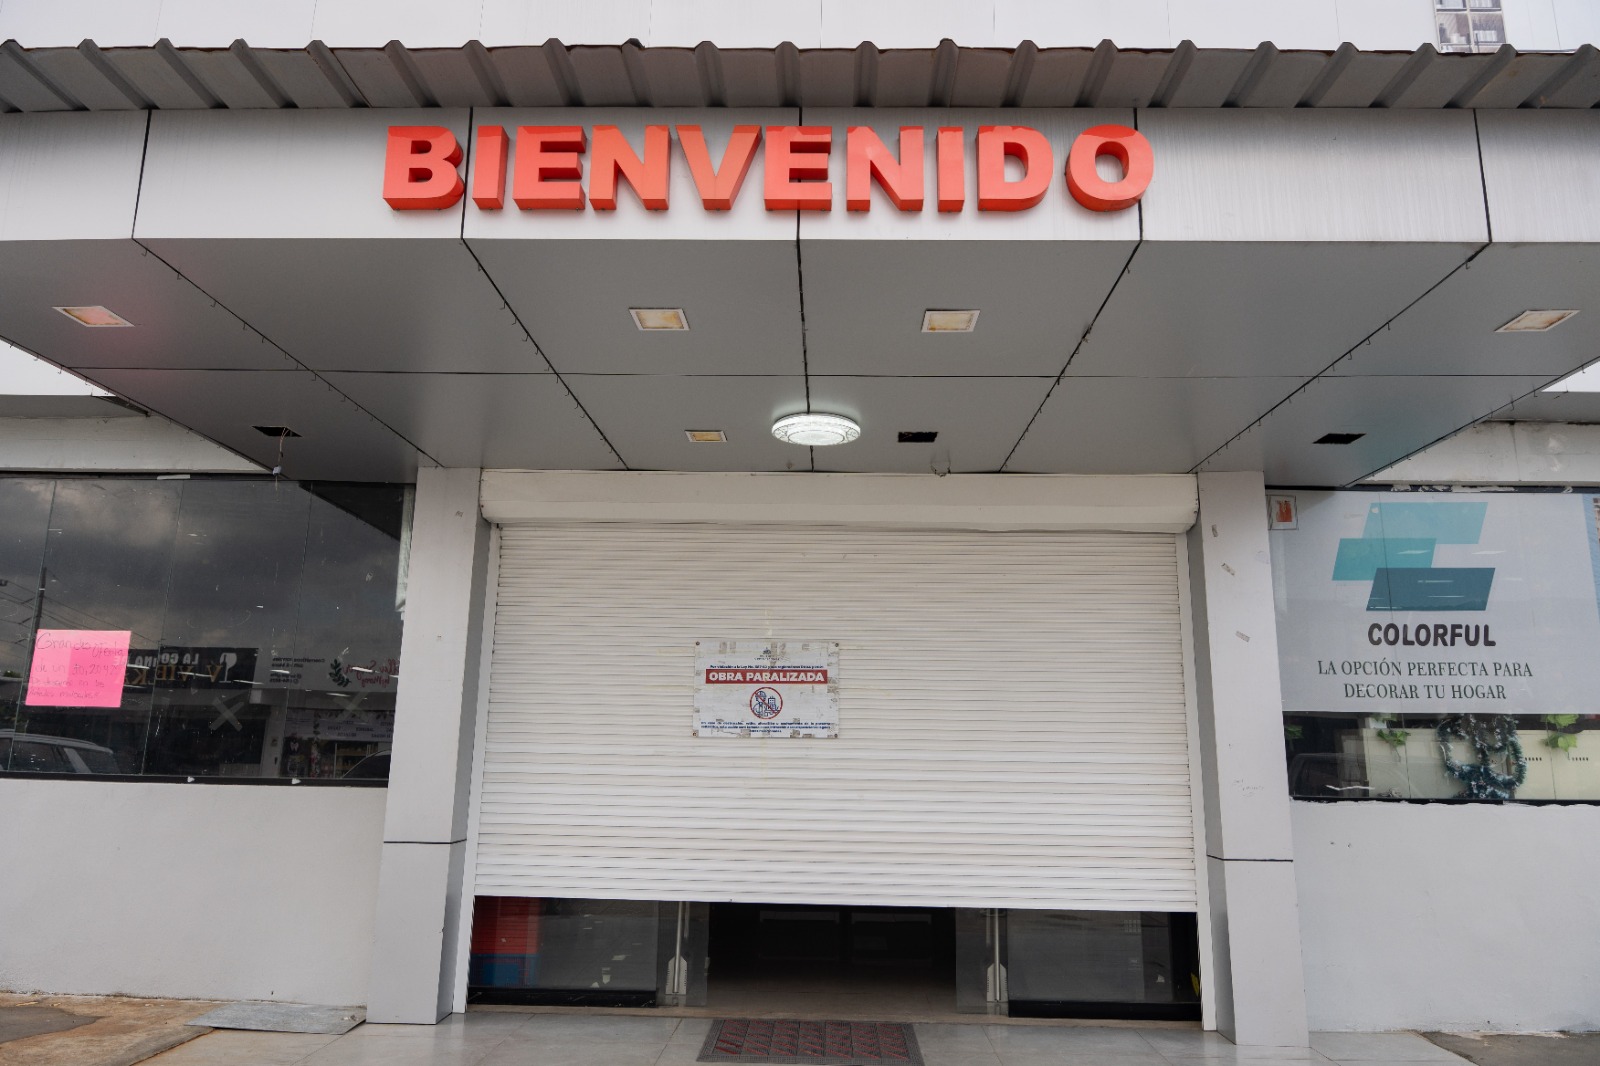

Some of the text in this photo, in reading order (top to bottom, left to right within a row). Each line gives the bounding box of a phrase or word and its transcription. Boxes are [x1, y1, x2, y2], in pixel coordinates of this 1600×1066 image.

[383, 125, 1154, 211] BIENVENIDO
[1367, 623, 1497, 647] COLORFUL
[709, 672, 825, 682] OBRA PARALIZADA
[1317, 657, 1533, 677] LA OPCIÓN PERFECTA PARA
[1344, 683, 1507, 699] DECORAR TU HOGAR
